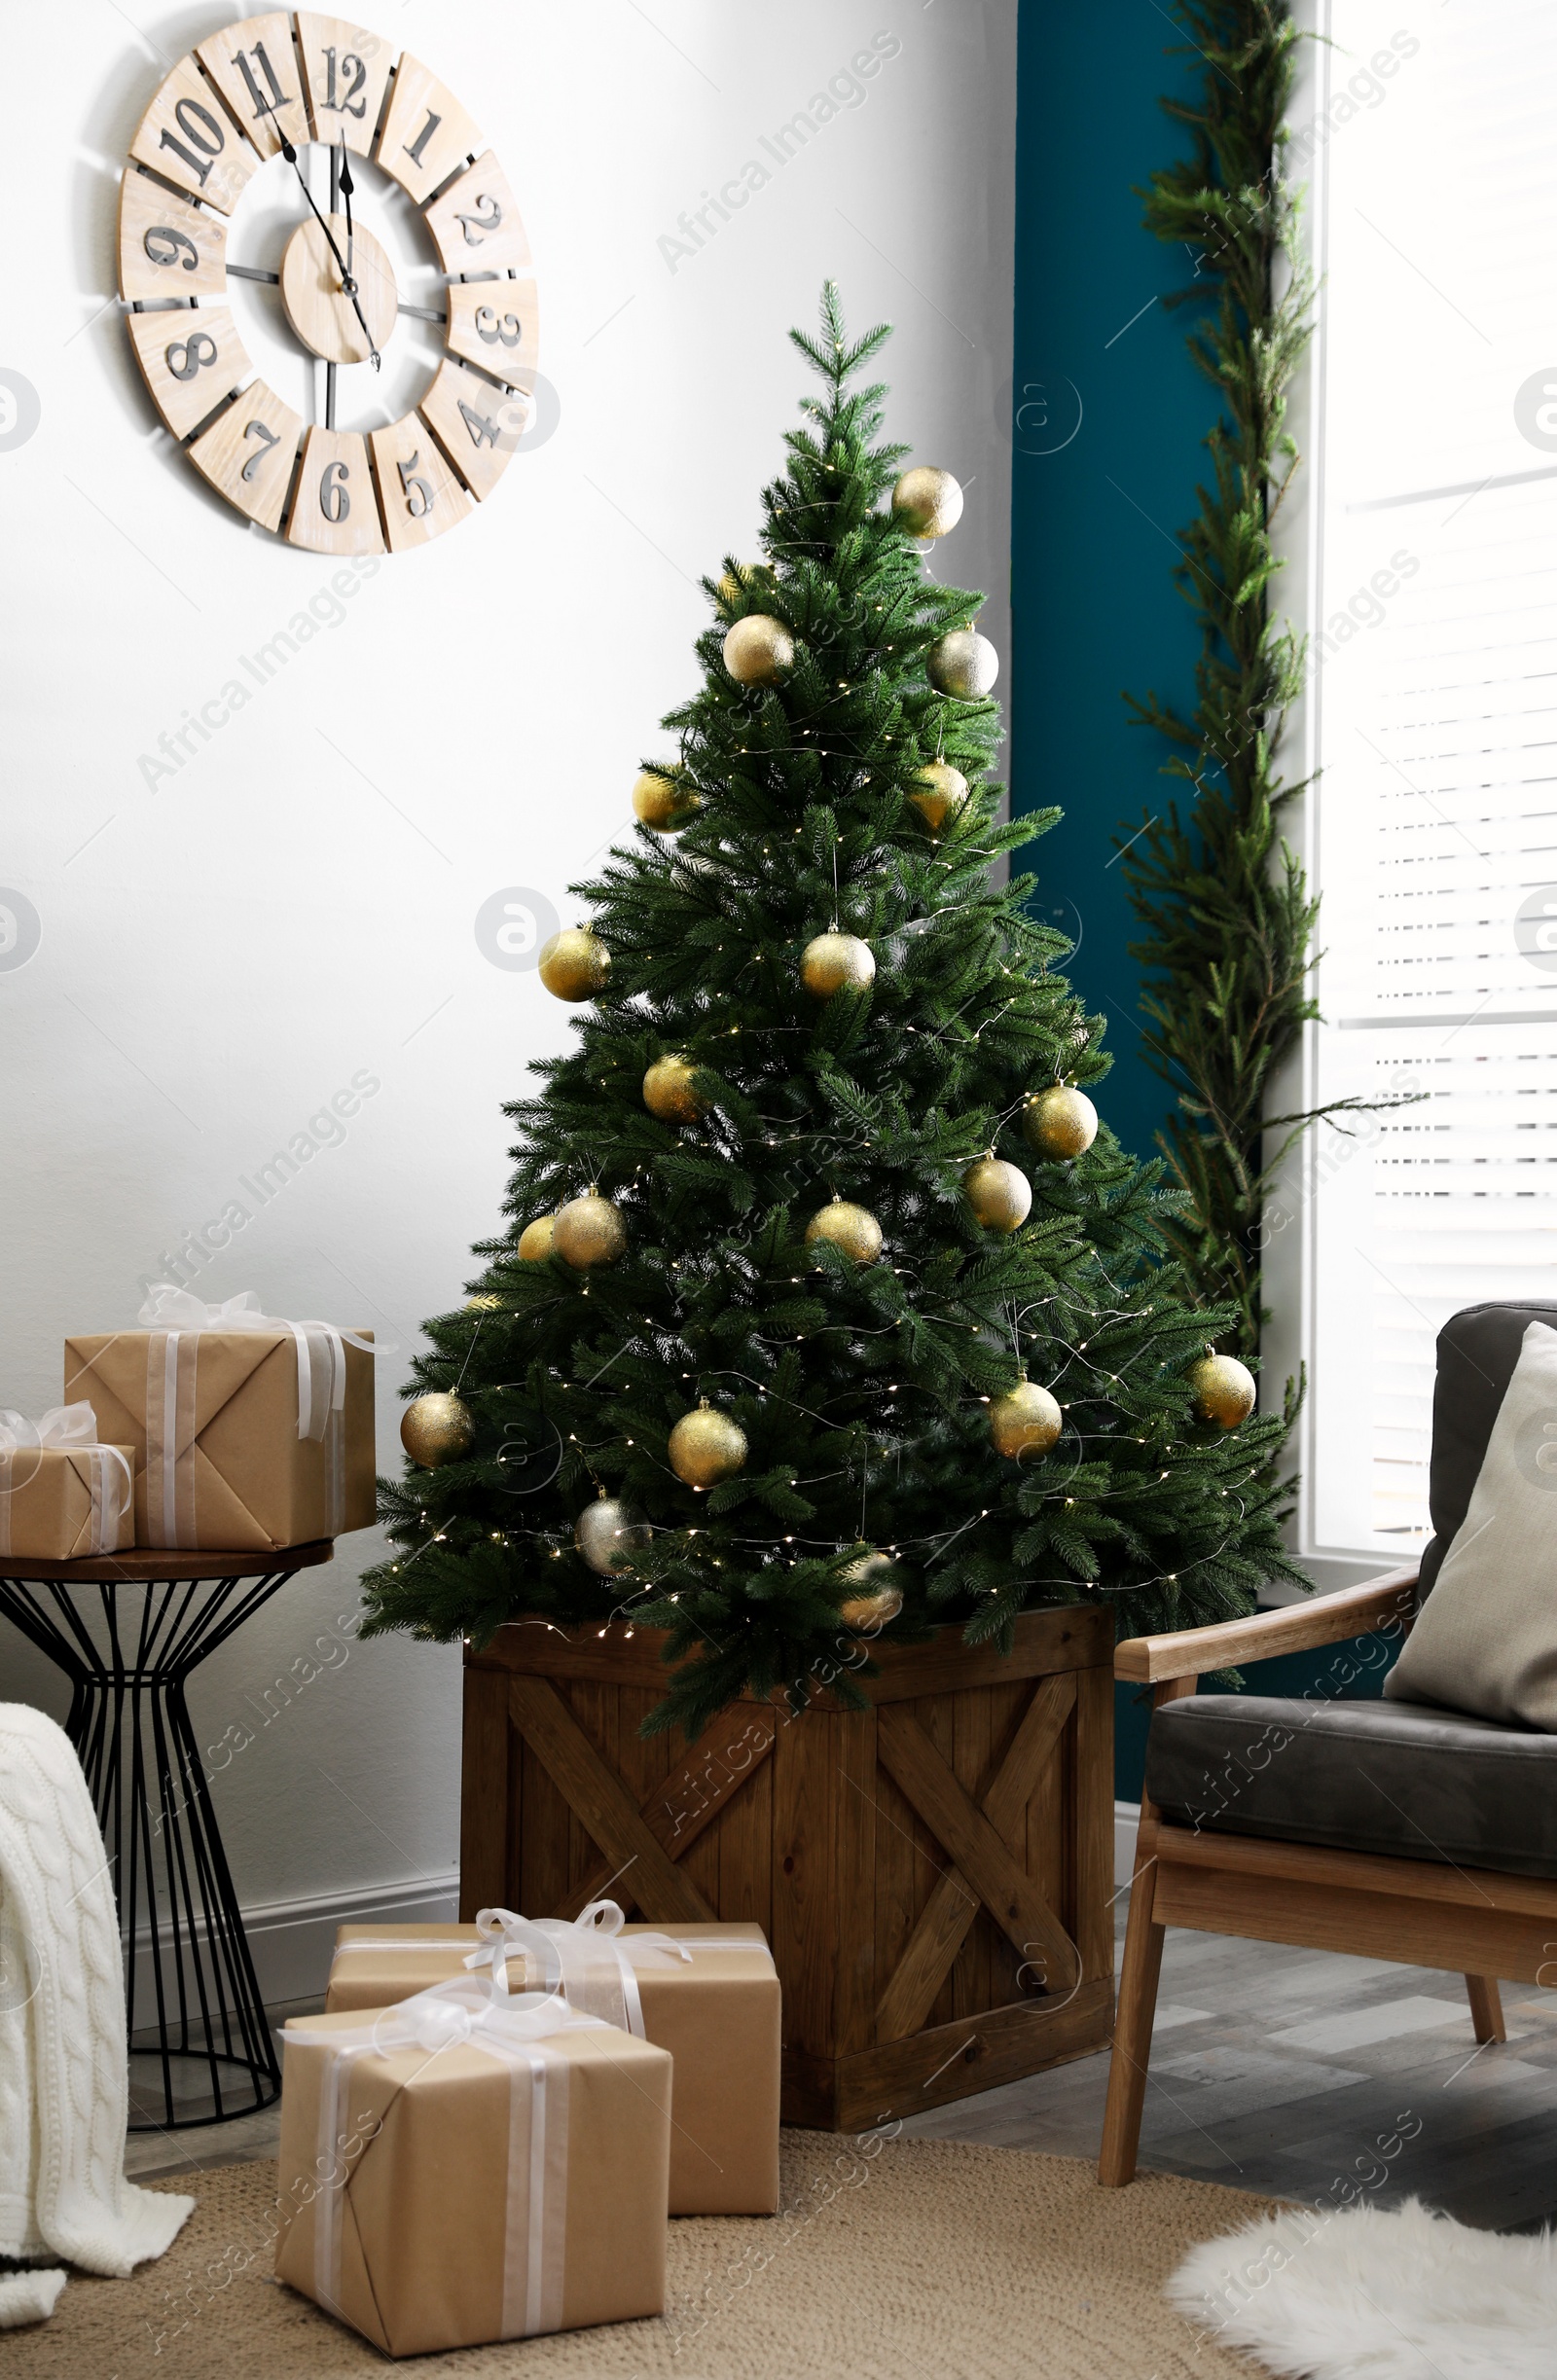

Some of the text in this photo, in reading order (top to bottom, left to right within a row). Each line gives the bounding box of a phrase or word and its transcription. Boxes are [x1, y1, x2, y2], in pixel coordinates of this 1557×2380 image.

[231, 41, 293, 120] 11
[320, 46, 367, 119] 12
[159, 98, 225, 187] 10
[403, 107, 442, 169] 1
[144, 225, 199, 270] 9
[455, 194, 502, 246] 2
[166, 332, 217, 381] 8
[474, 305, 522, 348] 3
[242, 419, 282, 483] 7
[456, 398, 500, 449] 4
[320, 461, 350, 523] 6
[396, 450, 433, 517] 5
